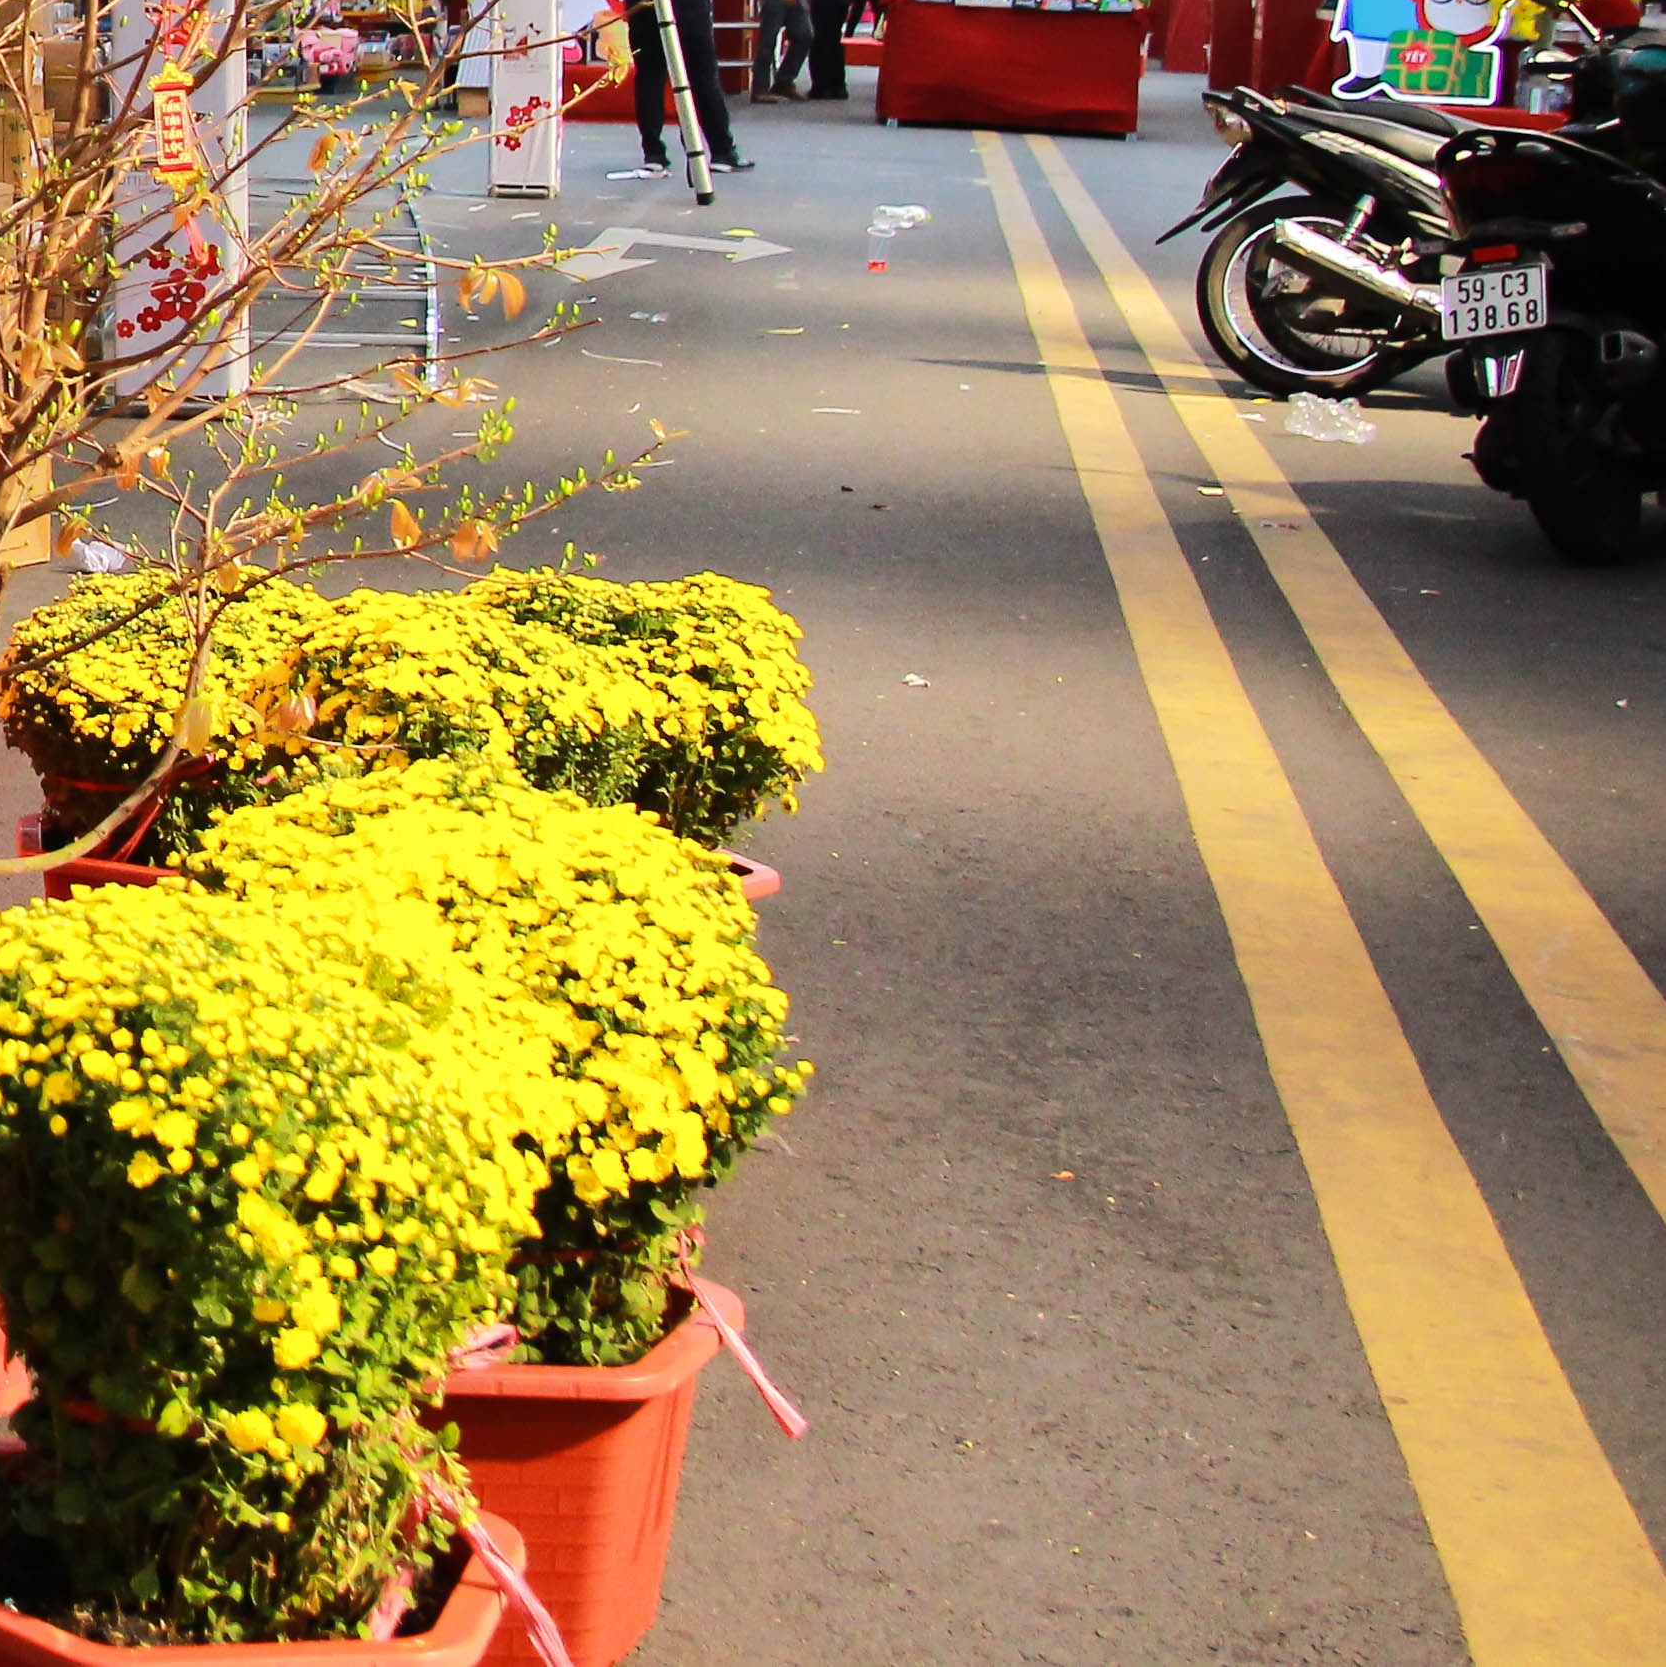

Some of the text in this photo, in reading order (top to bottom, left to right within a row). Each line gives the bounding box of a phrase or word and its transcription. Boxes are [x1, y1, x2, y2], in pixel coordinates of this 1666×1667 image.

[1404, 50, 1428, 64] TẾT
[1458, 270, 1530, 305] 59-C3
[1449, 301, 1541, 336] 138.68
